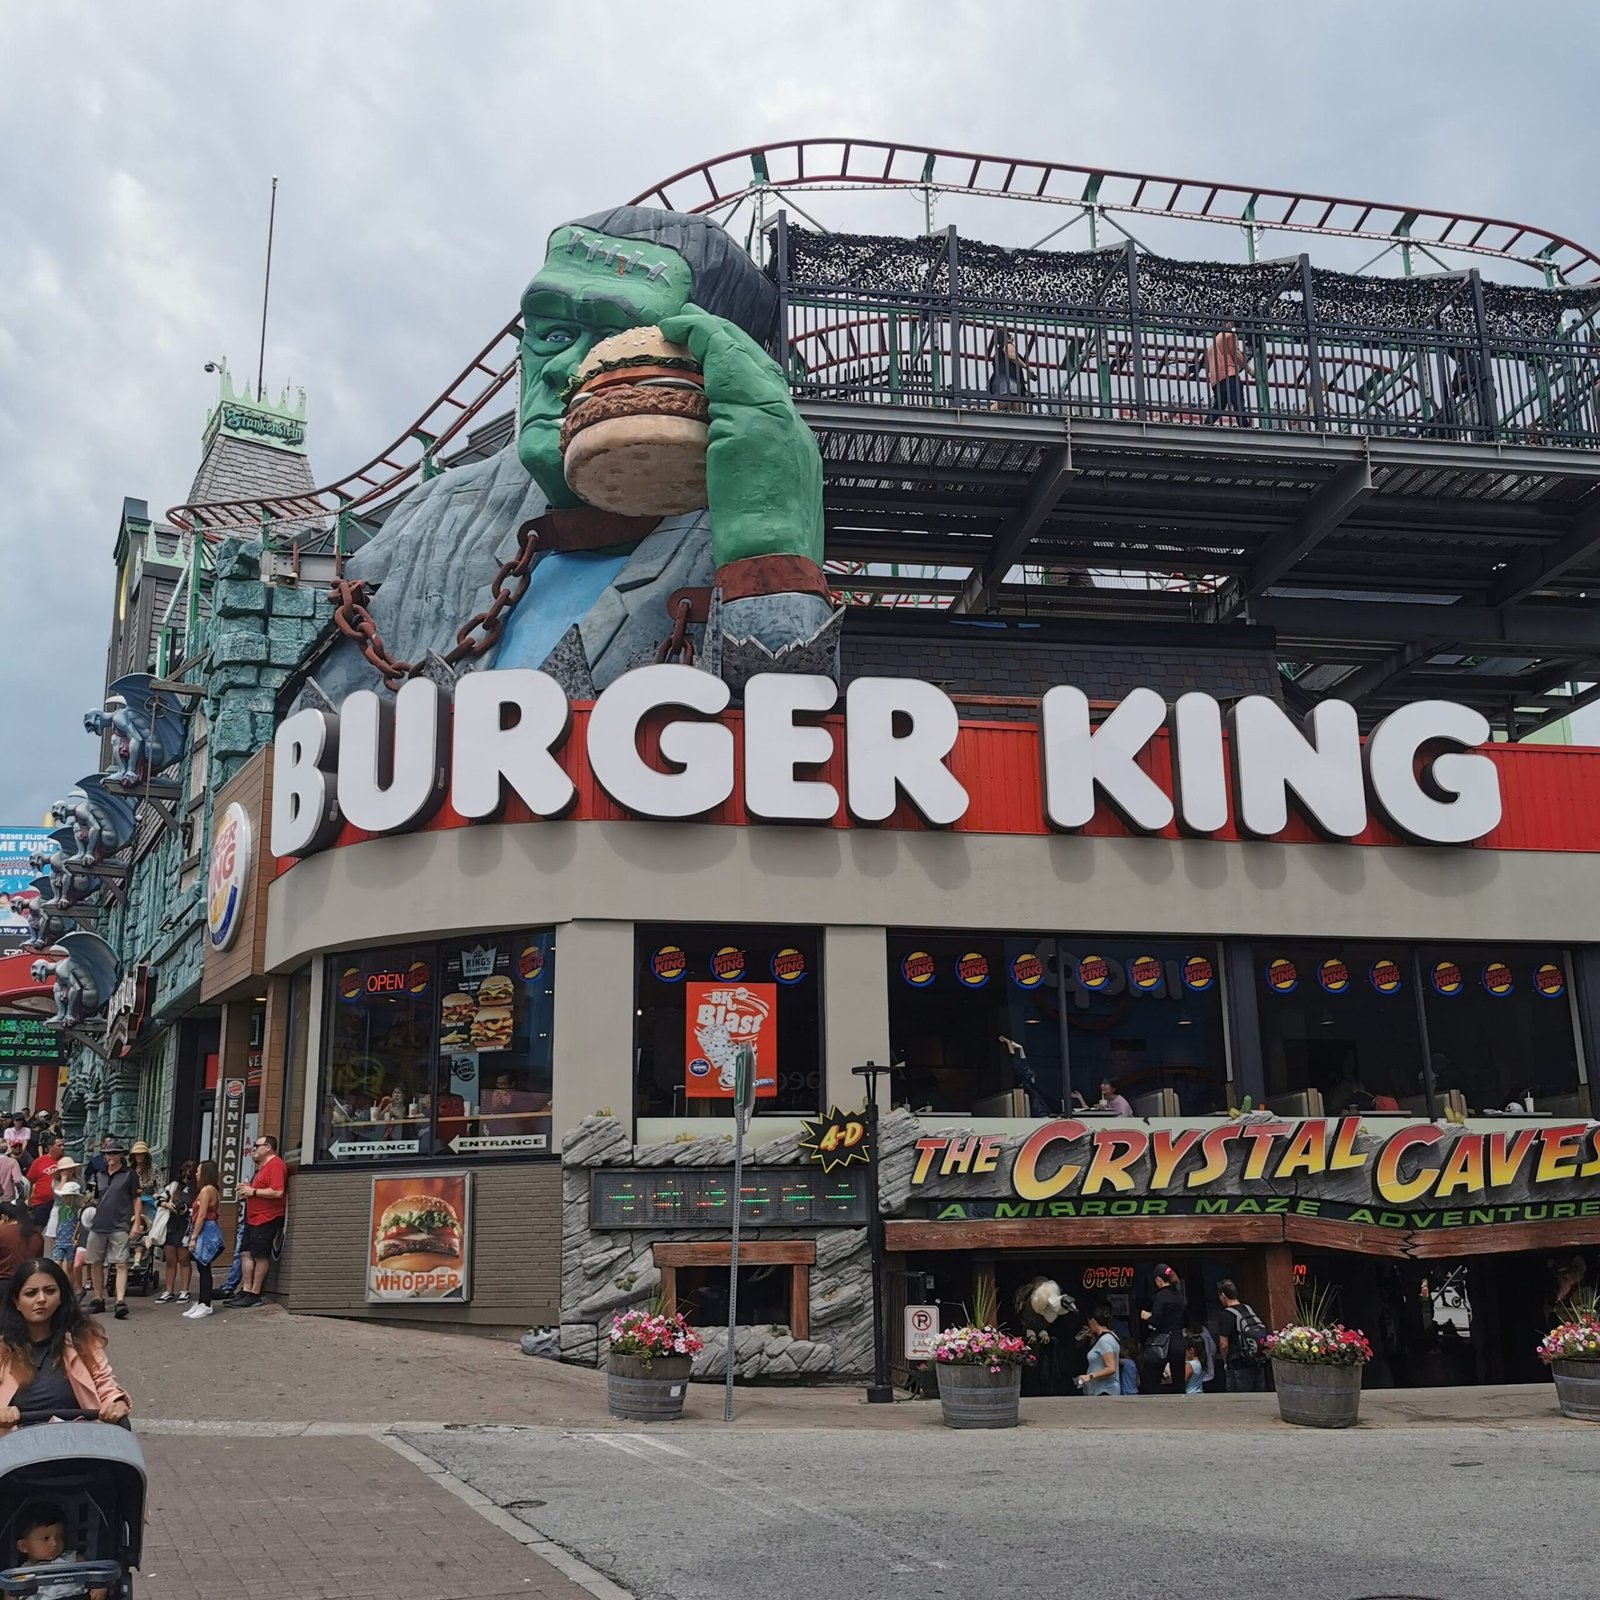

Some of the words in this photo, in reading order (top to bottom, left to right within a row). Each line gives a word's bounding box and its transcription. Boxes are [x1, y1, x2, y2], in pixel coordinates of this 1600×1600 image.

[225, 407, 302, 443] Frankenstein
[271, 662, 970, 858] BURGER
[1042, 684, 1502, 843] KING
[466, 957, 491, 968] KING'S
[655, 951, 685, 964] BURGER
[714, 952, 744, 965] BURGER
[774, 953, 804, 966] BURGER
[905, 956, 932, 970] BURGER
[959, 958, 986, 972] BURGER
[1014, 958, 1041, 972] BURGER
[1080, 959, 1107, 972] BURGER
[655, 958, 686, 974] KING
[714, 959, 745, 974] KING
[774, 960, 806, 976] KING
[906, 963, 934, 980] KING
[960, 965, 988, 982] KING
[1015, 966, 1043, 982] KING
[1081, 966, 1109, 982] KING
[1133, 960, 1160, 974] BURGER
[1185, 961, 1212, 974] BURGER
[367, 973, 404, 992] OPEN
[1134, 967, 1162, 984] KING
[1186, 968, 1214, 984] KING
[1271, 970, 1296, 985] KING
[1322, 971, 1348, 986] KING
[1374, 972, 1400, 987] KING
[1436, 974, 1462, 988] KING
[1487, 974, 1512, 990] KING
[1538, 976, 1564, 991] KING
[711, 991, 738, 1011] BK
[696, 1004, 764, 1034] Blast
[459, 1137, 543, 1148] ENTRANCE
[821, 1122, 863, 1150] 4-D
[222, 1098, 240, 1198] ENTRANCE
[338, 1142, 416, 1154] ENTRANCE
[911, 1133, 1006, 1185] THE
[1012, 1115, 1371, 1201] CRYSTAL
[936, 1203, 966, 1219] A
[1194, 1198, 1321, 1216] MAZE
[1347, 1201, 1600, 1228] ADVENTURE
[375, 1273, 459, 1291] WHOPPER
[1082, 1266, 1134, 1289] OPEN
